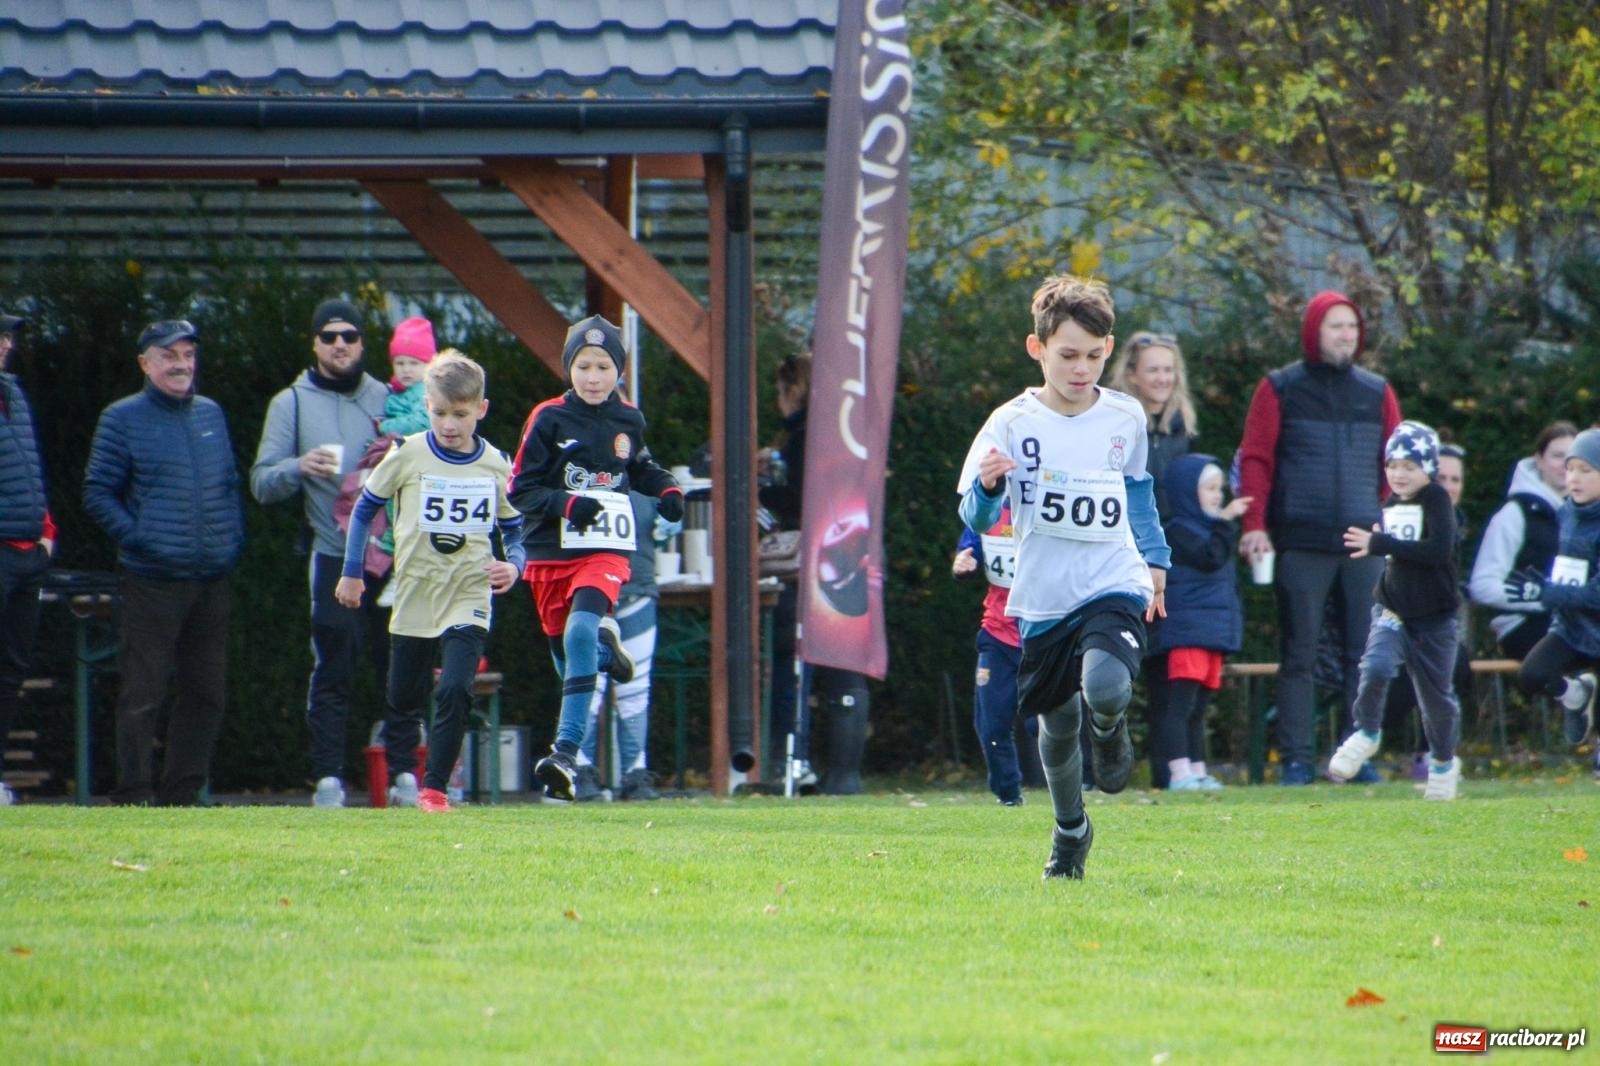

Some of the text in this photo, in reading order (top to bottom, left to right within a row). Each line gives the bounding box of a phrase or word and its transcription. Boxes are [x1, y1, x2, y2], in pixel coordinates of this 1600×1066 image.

[1021, 437, 1041, 472] 9
[424, 496, 490, 523] 554
[1040, 491, 1121, 528] 509
